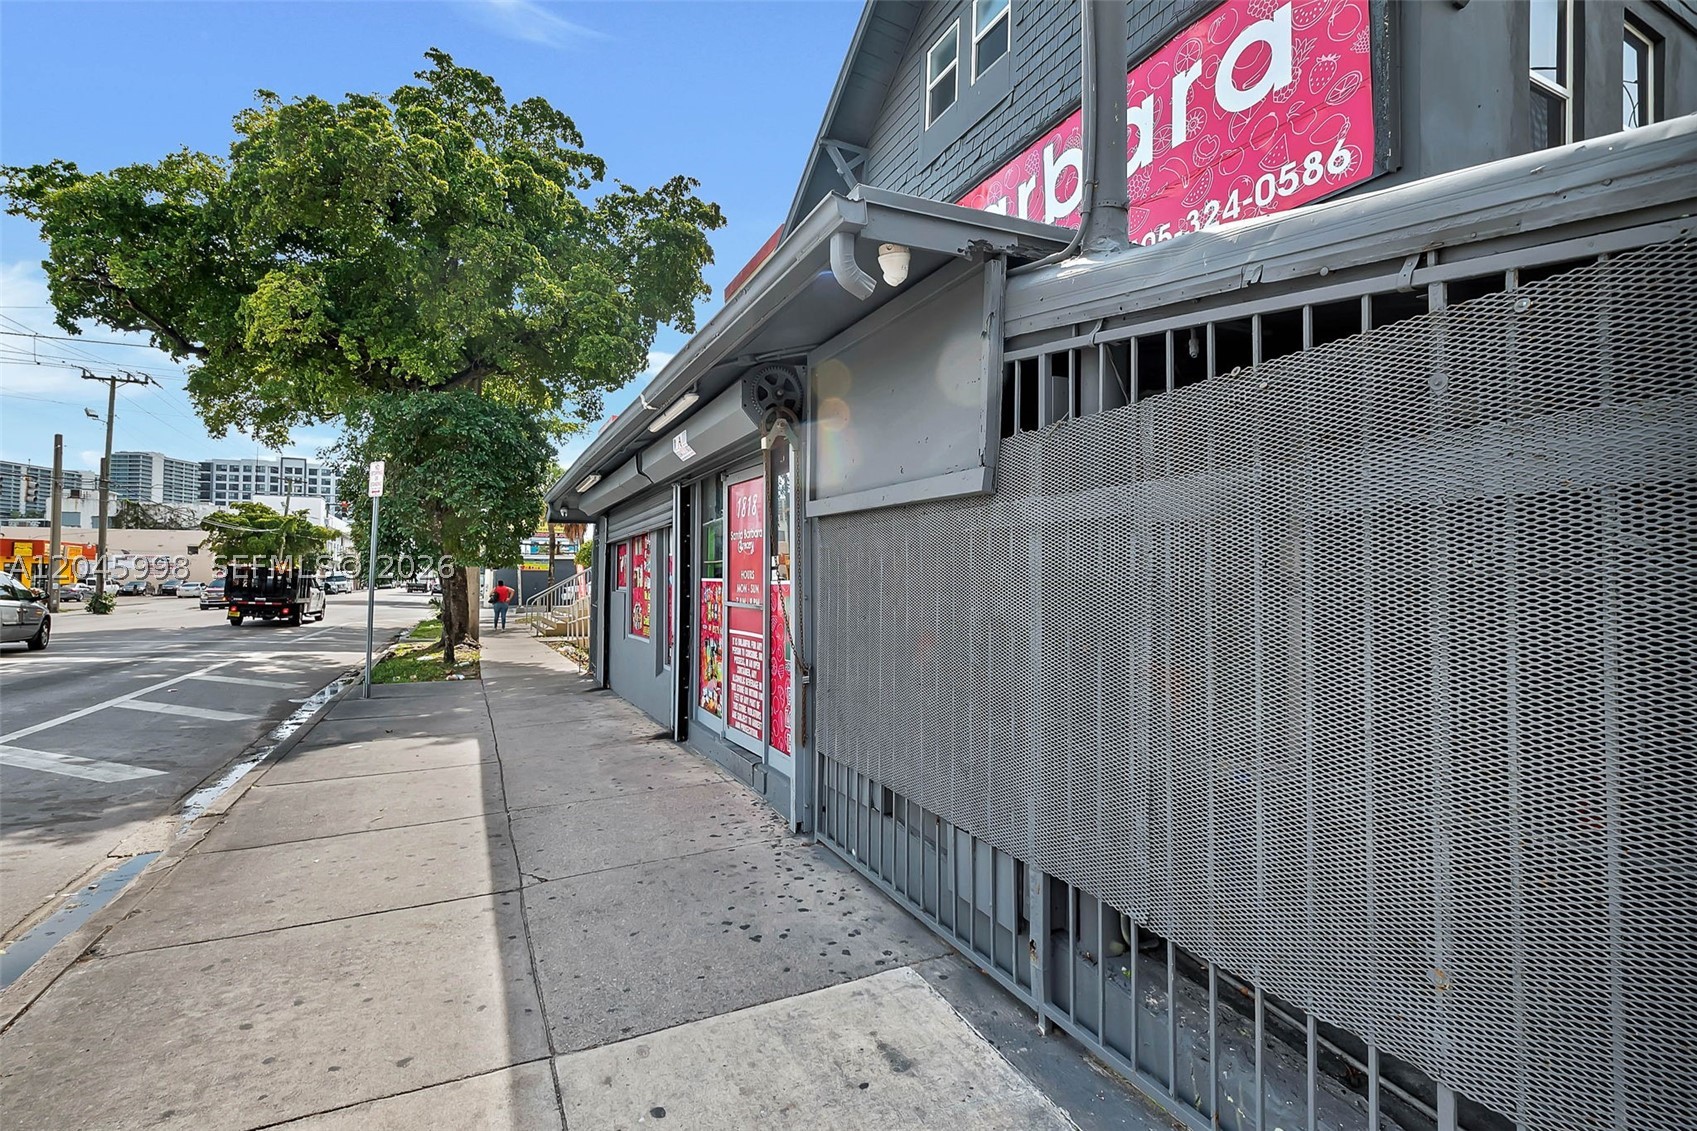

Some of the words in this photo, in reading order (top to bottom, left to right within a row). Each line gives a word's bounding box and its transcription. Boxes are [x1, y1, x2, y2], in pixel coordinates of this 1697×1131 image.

[736, 493, 758, 519] 1818
[743, 528, 763, 539] Barbara
[740, 569, 755, 580] HOURS
[736, 583, 748, 593] MON
[750, 583, 760, 594] SUN
